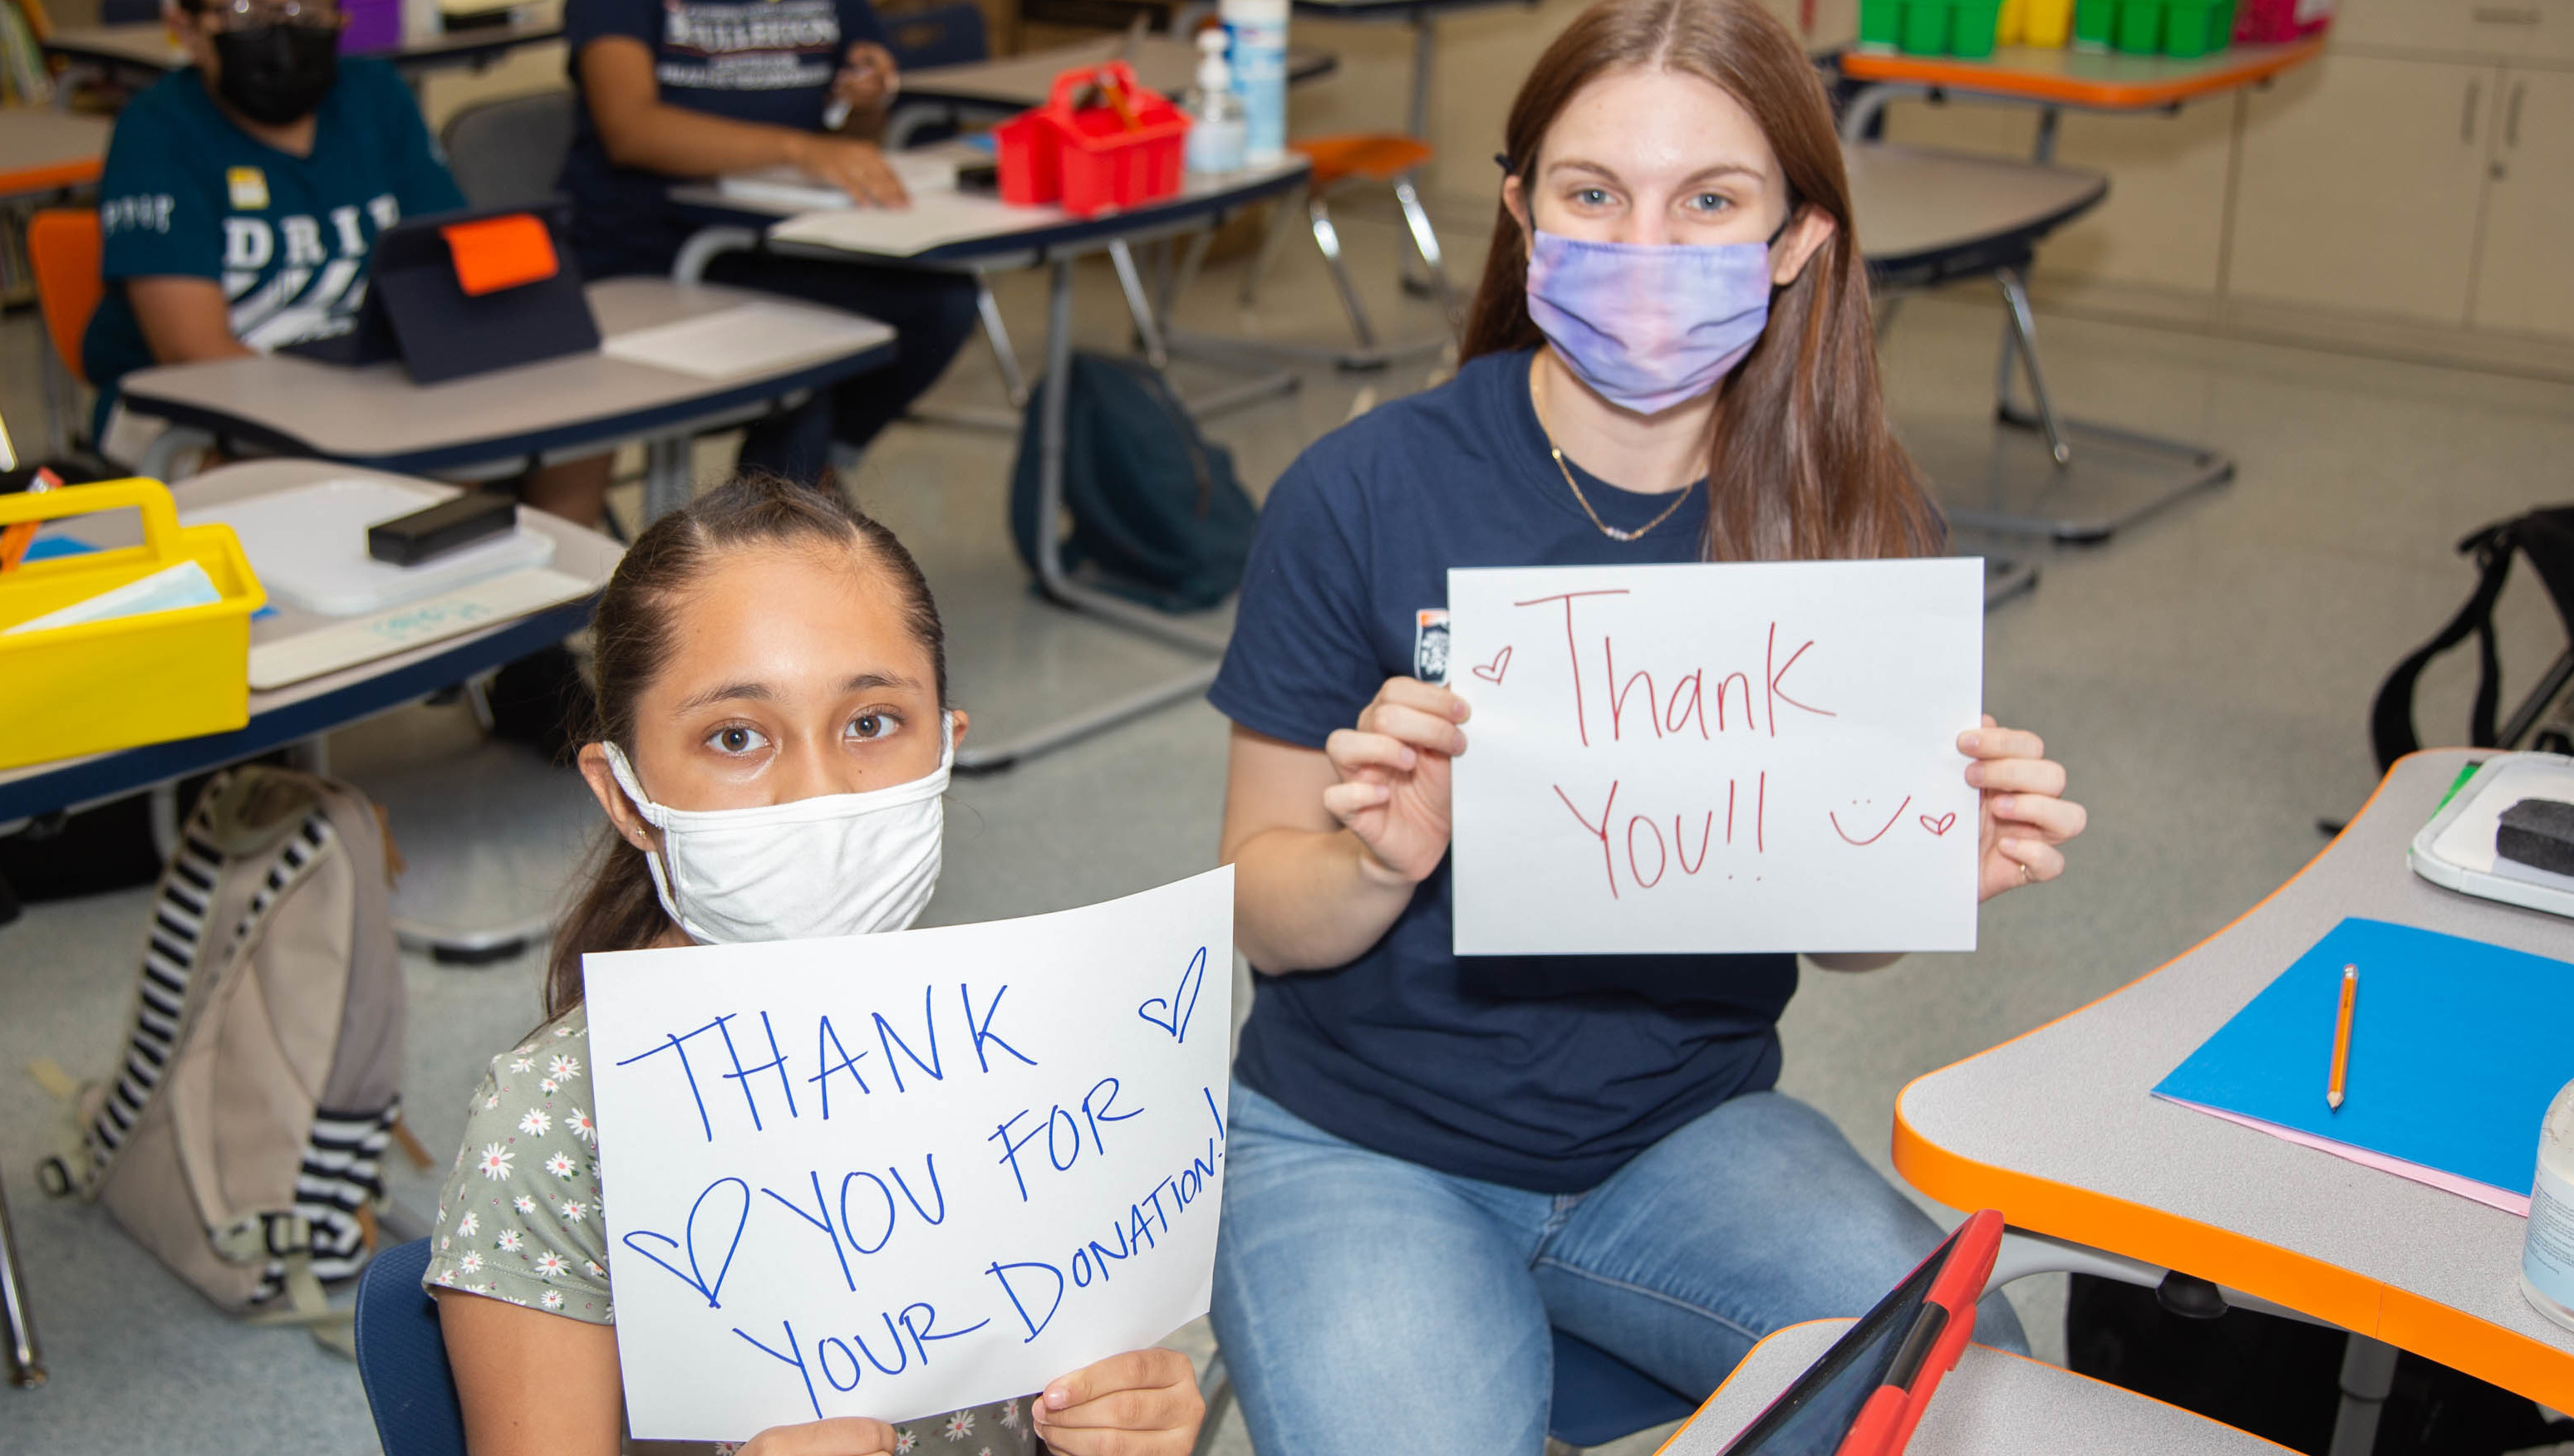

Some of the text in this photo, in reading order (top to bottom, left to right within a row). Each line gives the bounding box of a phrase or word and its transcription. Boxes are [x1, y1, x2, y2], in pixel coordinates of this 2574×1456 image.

[1515, 588, 1836, 746] Thank
[616, 983, 1038, 1142] THANK
[733, 1086, 1225, 1419] YOUR DONATION!
[762, 1076, 1144, 1292] YOU FOR
